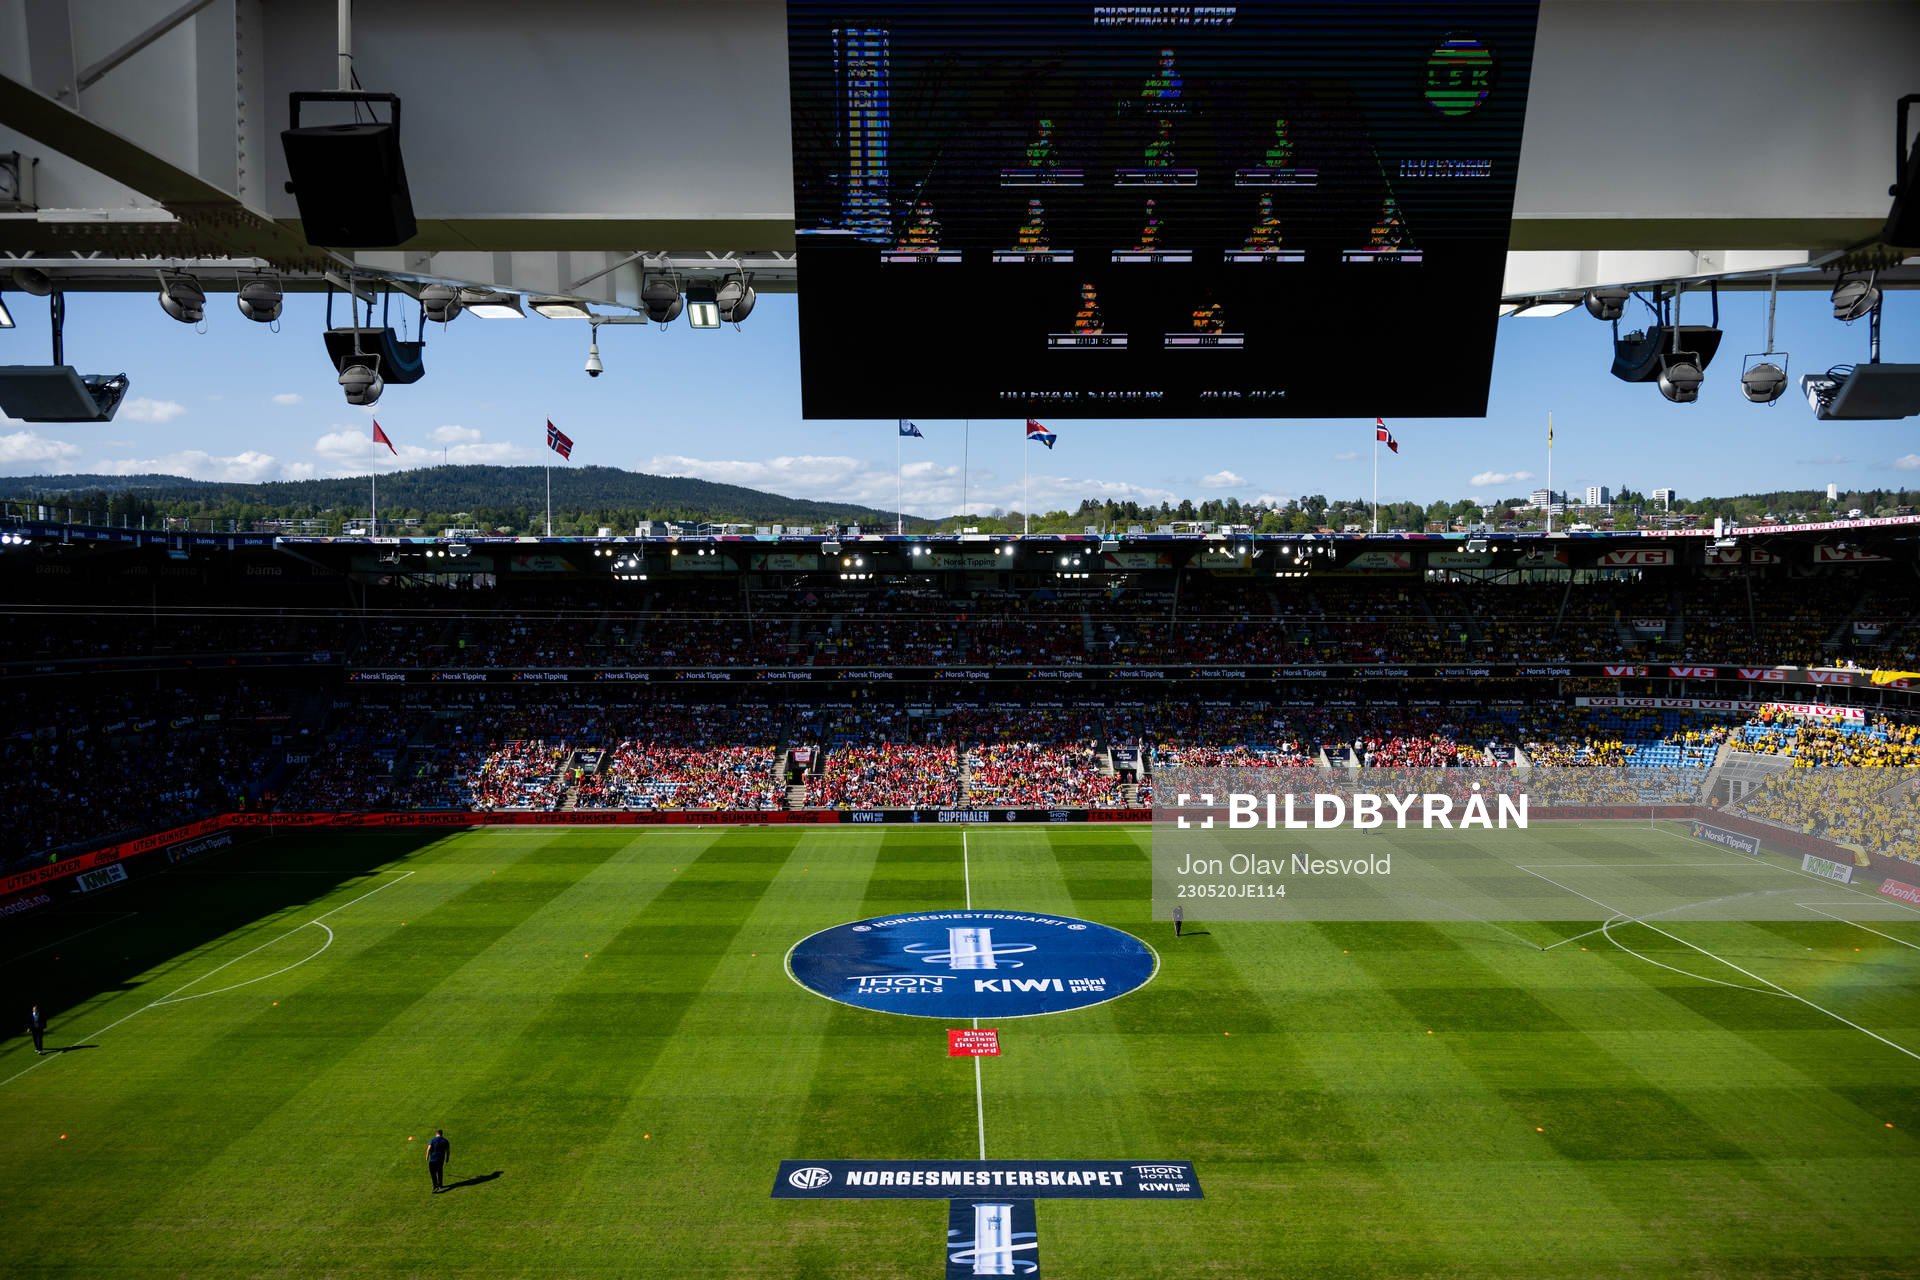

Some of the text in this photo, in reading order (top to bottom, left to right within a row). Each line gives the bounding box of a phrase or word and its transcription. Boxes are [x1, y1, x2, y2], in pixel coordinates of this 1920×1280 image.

[943, 557, 996, 567] Norsk Tipping
[1605, 551, 1667, 565] VG
[361, 672, 405, 682] Norsk Tipping
[443, 672, 486, 682] Norsk Tipping
[523, 672, 568, 682] Norsk Tipping
[605, 672, 649, 682] Norsk Tipping
[686, 672, 730, 682] Norsk Tipping
[767, 672, 811, 682] Norsk Tipping
[849, 671, 892, 681] Norsk Tipping
[945, 671, 989, 681] Norsk Tipping
[1038, 671, 1082, 681] Norsk Tipping
[1120, 670, 1164, 680] Norsk Tipping
[1202, 670, 1245, 680] Norsk Tipping
[1283, 670, 1327, 680] Norsk Tipping
[1364, 669, 1408, 679] Norsk Tipping
[1445, 668, 1489, 678] Norsk Tipping
[1527, 667, 1571, 677] Norsk Tipping
[1670, 667, 1715, 678] VG
[1739, 669, 1785, 680] VG
[1808, 671, 1850, 684] VG
[1591, 698, 1617, 706] VG
[1626, 698, 1654, 706] VG
[1662, 699, 1692, 707] VG
[1700, 701, 1732, 709] VG
[1816, 708, 1846, 716] VG
[384, 814, 466, 824] UTEN SUKKER
[535, 813, 617, 823] UTEN SUKKER
[686, 813, 769, 823] UTEN SUKKER
[852, 812, 873, 822] KIWI
[938, 811, 989, 822] CUPFINALEN
[134, 838, 156, 851] UTEN
[1704, 830, 1752, 853] Norsk Tipping
[1807, 856, 1835, 879] KIWI
[7, 860, 81, 889] UTEN SUKKER
[83, 870, 112, 890] KIWI
[873, 913, 1068, 929] NORGESMESTERSKAPET
[974, 978, 1064, 992] KIWI
[1070, 985, 1105, 993] pris
[1133, 1165, 1185, 1174] THON
[846, 1171, 1123, 1186] NORGESMESTERSKAPET
[1138, 1183, 1174, 1192] KIWI
